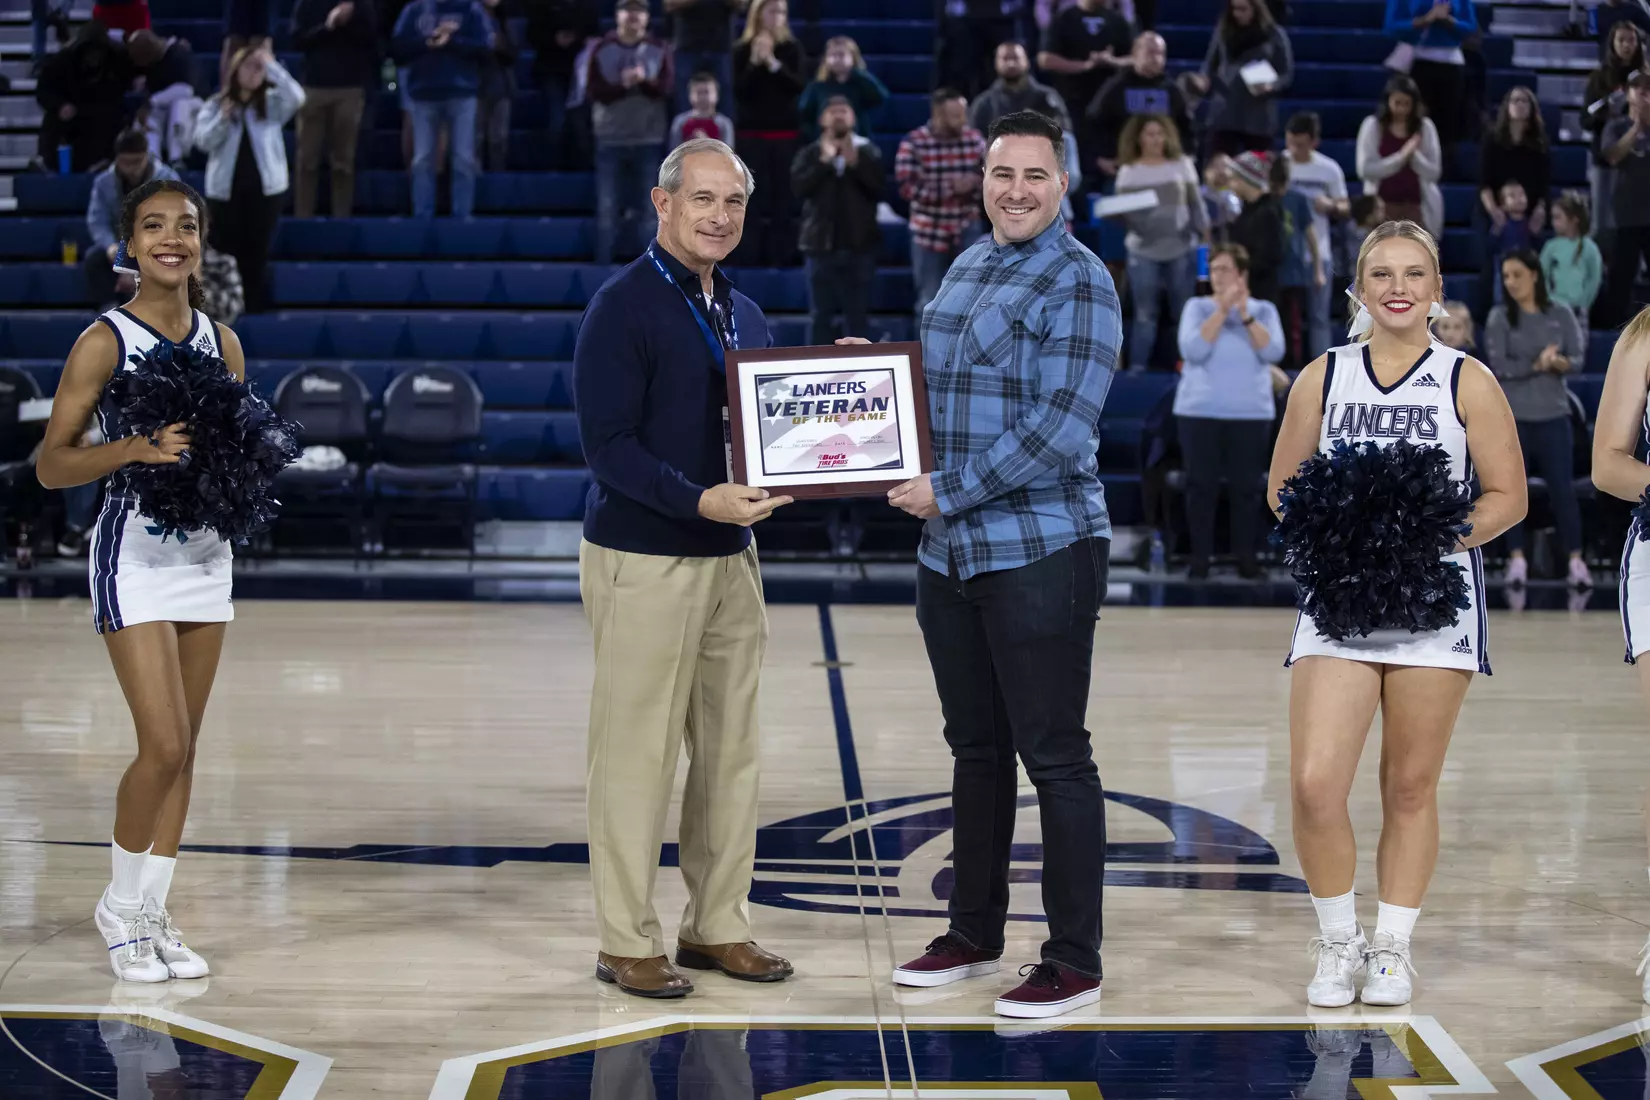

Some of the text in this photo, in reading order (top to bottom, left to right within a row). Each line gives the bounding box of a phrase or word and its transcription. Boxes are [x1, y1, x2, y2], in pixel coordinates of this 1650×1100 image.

[792, 381, 866, 397] LANCERS
[1412, 381, 1440, 389] adidas
[765, 397, 889, 417] VETERAN
[792, 411, 887, 425] OF THE GAME
[1327, 403, 1439, 440] LANCERS
[822, 452, 847, 460] Bud's
[1452, 645, 1473, 655] adidas
